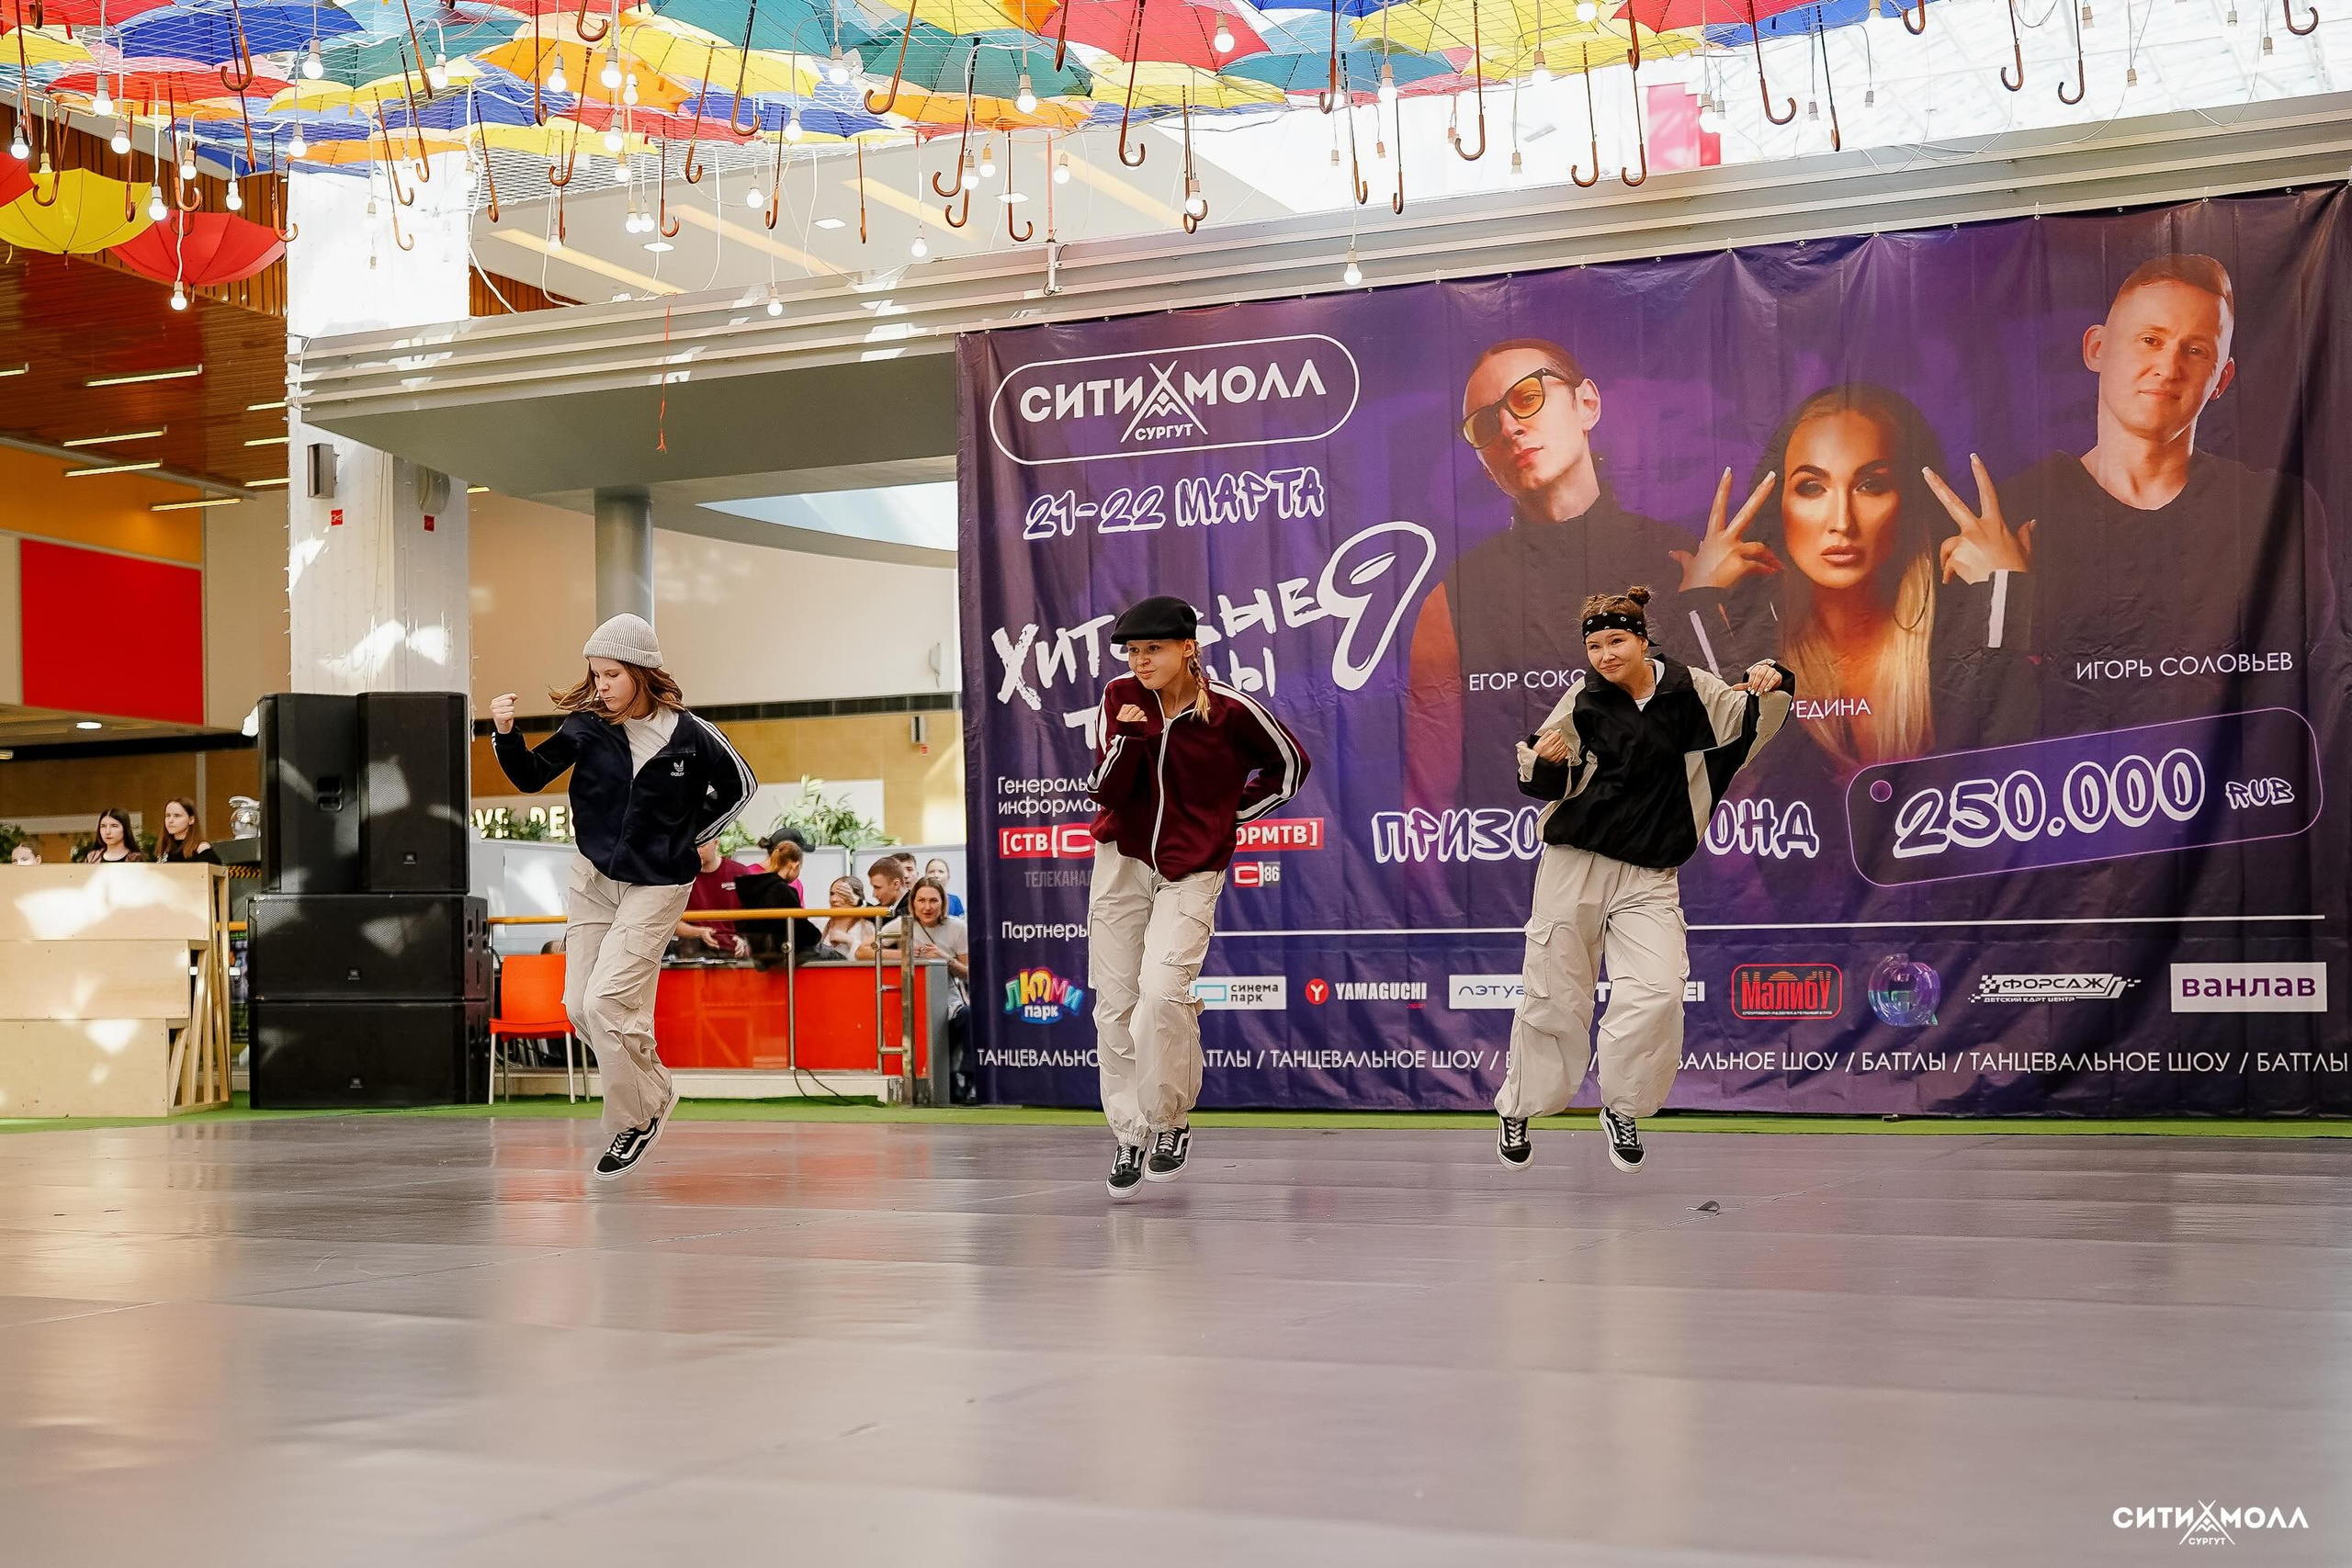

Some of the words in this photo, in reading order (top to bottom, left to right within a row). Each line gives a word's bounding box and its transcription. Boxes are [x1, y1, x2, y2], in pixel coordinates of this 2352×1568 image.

[1020, 375, 1143, 423] СИТИ
[1184, 358, 1327, 406] МОЛЛ
[1135, 423, 1193, 441] СУРГУТ
[1023, 485, 1167, 540] 21-22
[1175, 467, 1324, 527] МАРТА
[991, 578, 1320, 711] ХИТЫЕ
[2076, 658, 2154, 681] ИГОРЬ
[2160, 651, 2294, 676] СОЛОВЬЕВ
[1469, 672, 1519, 691] ЕГОР
[997, 776, 1088, 796] Генераль
[1892, 748, 2206, 860] 250.000
[2224, 777, 2296, 809] RUB
[1236, 820, 1318, 847] ОРМТВ]
[1371, 806, 1544, 863] ПРИЗО
[1704, 798, 1820, 860] ОНД
[1230, 983, 1279, 993] синема
[1335, 982, 1427, 1001] YAMAGUCHI
[2002, 977, 2106, 989] ФОРСАЖ
[2181, 977, 2316, 998] ванлав
[1230, 993, 1263, 1004] парк
[1023, 1004, 1059, 1021] парк
[978, 1048, 1100, 1068] ТАНЦЕВАЛЬНО
[1202, 1049, 1250, 1068] ТТЛЫ
[1270, 1049, 1426, 1071] ТАНЦЕВАЛЬНОЕ
[1431, 1049, 1484, 1069] ШОУ
[1781, 1052, 1838, 1071] ШОУ
[1861, 1052, 1946, 1071] БАТТЛЫ
[1969, 1052, 2160, 1074] ТАНЦЕВАЛЬНОЕ
[2168, 1052, 2231, 1072] ШОУ
[2257, 1052, 2348, 1072] БАТТЛЫ
